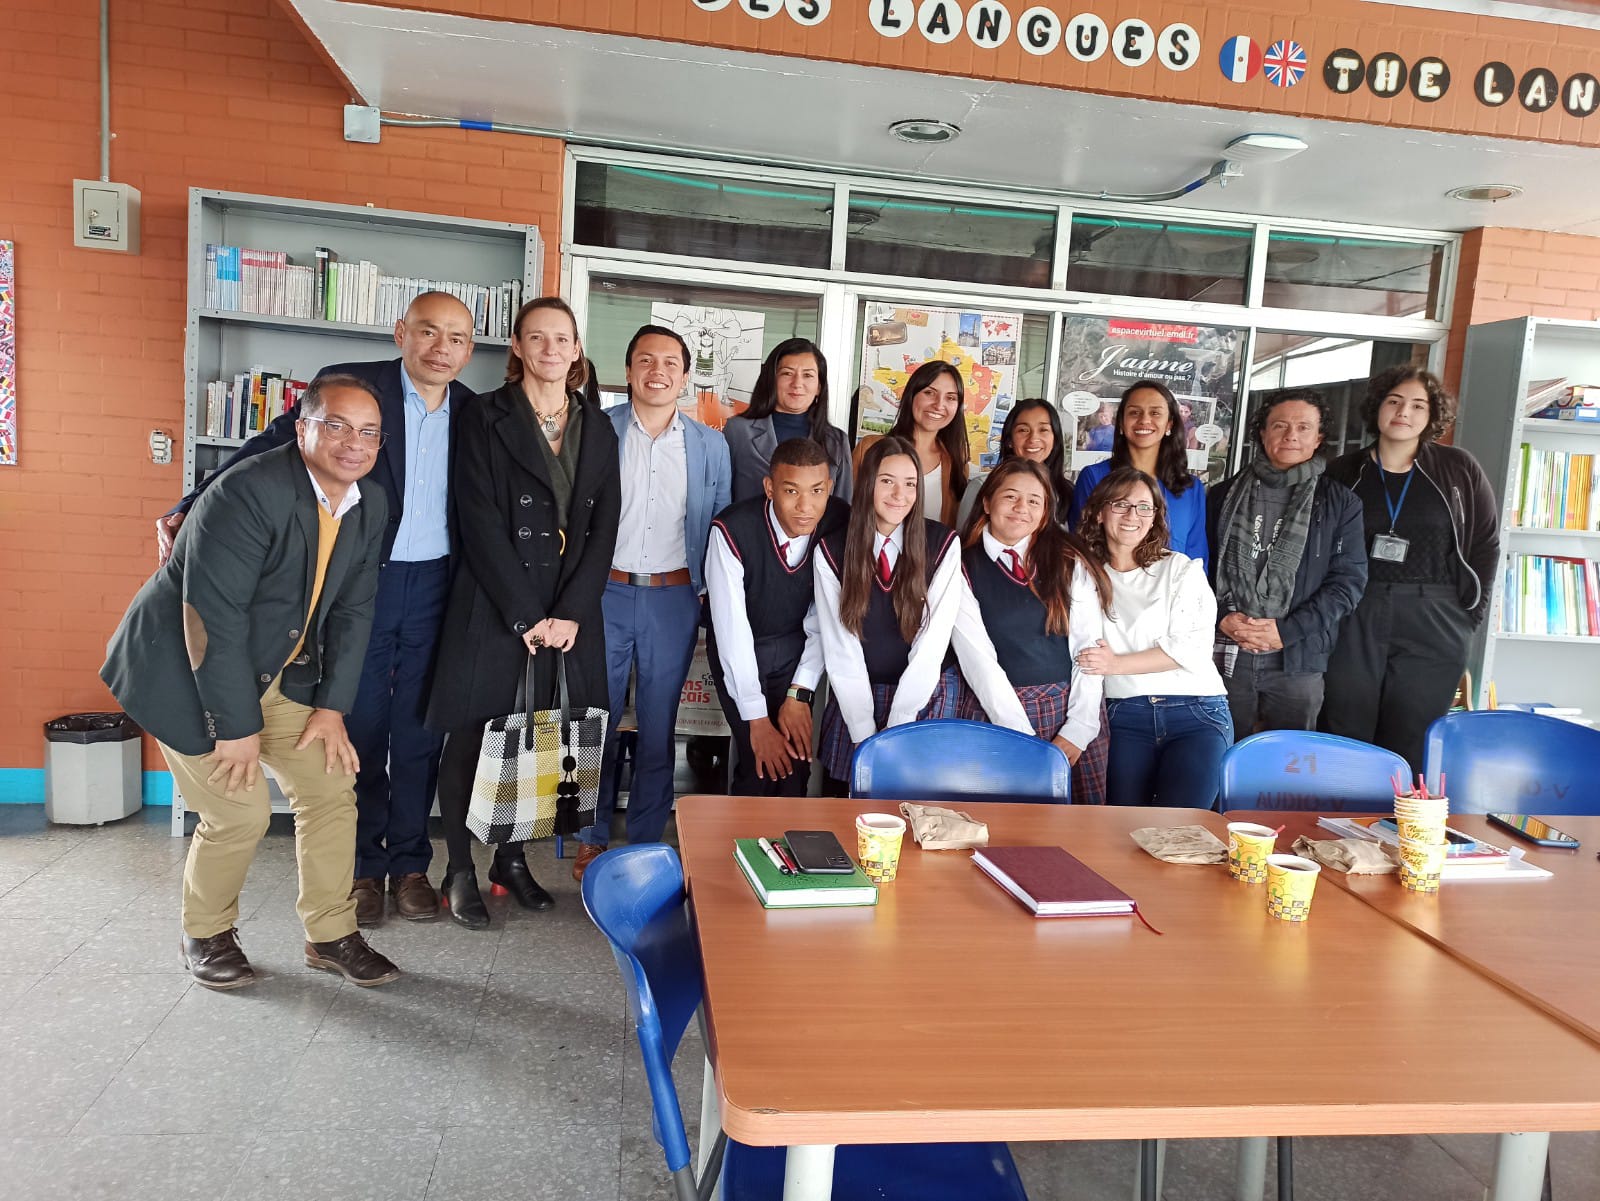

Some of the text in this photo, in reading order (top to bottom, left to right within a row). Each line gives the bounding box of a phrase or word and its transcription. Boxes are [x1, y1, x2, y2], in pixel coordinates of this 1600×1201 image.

[882, 0, 1190, 66] LANGUES
[1333, 57, 1595, 111] THE LAN
[1111, 326, 1195, 340] espacevirtuel.emdl.fr
[1079, 344, 1193, 381] J'aime
[1113, 369, 1138, 378] Histoire
[1138, 371, 1164, 380] d'amour
[1283, 752, 1317, 775] 21
